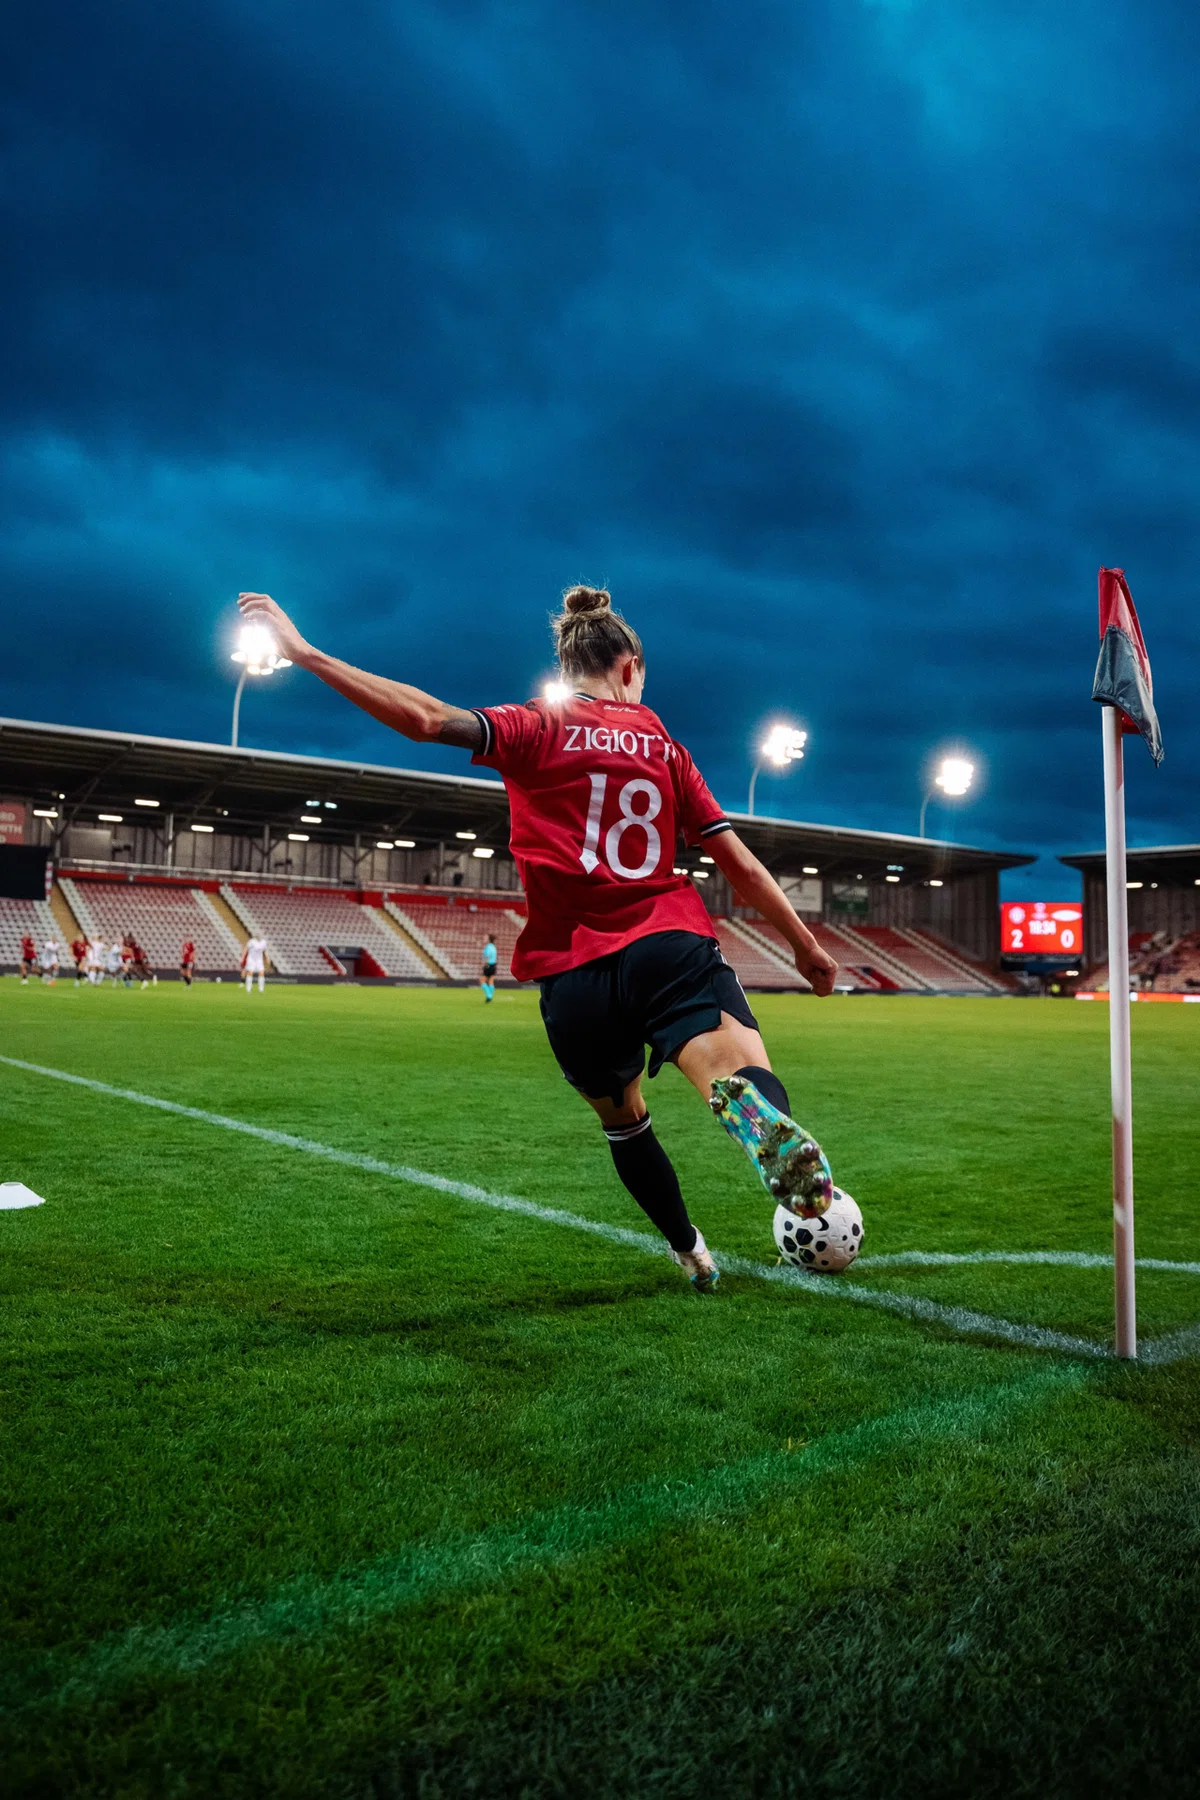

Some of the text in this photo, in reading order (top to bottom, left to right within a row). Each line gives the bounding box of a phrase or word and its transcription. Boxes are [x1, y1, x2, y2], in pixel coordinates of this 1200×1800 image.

[579, 772, 662, 879] 18
[1011, 929, 1024, 949] 2
[1060, 928, 1075, 949] 0
